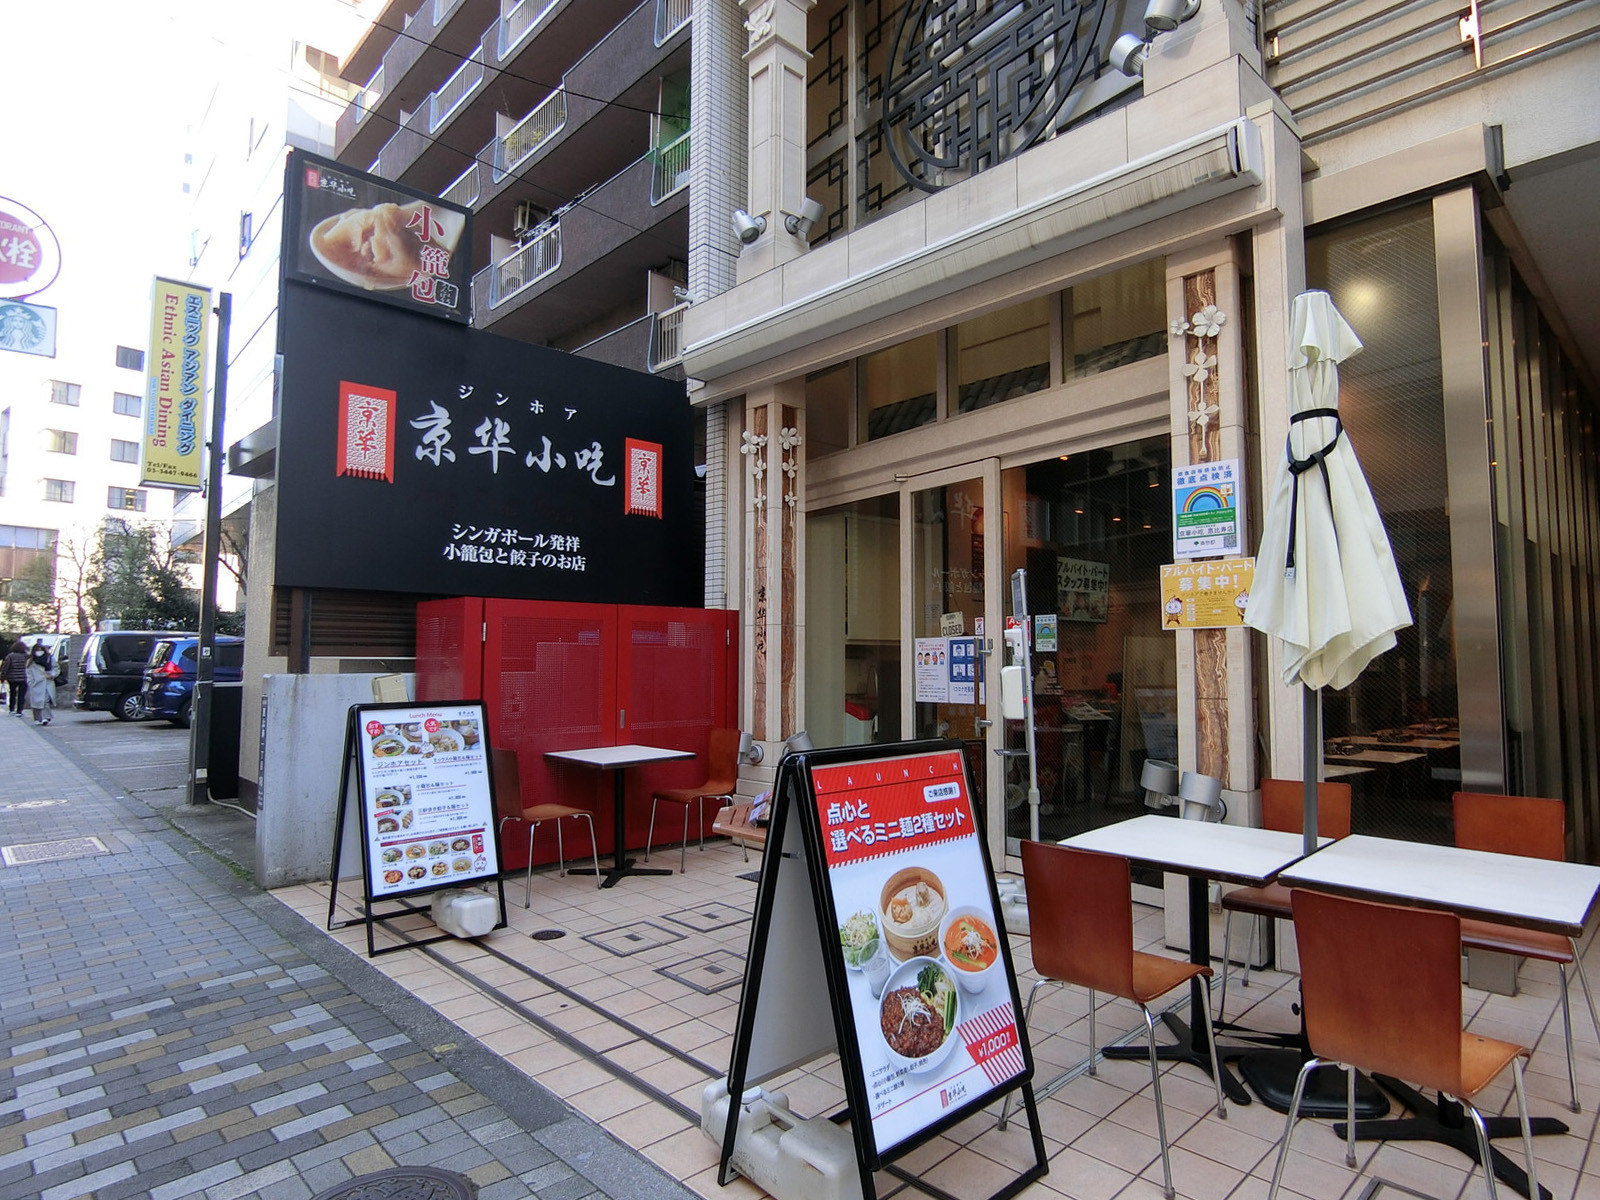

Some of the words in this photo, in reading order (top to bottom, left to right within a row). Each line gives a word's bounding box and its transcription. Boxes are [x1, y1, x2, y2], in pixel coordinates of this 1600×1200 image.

[0, 220, 29, 234] DRANT
[406, 205, 450, 304] 小籠包
[163, 293, 179, 344] Ethnic
[184, 294, 202, 346] エスニック
[160, 348, 175, 392] Asian
[180, 348, 200, 395] アジアン
[458, 384, 578, 421] ジンホア
[153, 397, 172, 447] Dining
[147, 461, 177, 469] Tel/Fax
[452, 523, 580, 552] シンガポール発祥
[443, 543, 586, 571] 小籠包と餃子のお店
[1163, 560, 1252, 577] アルバイト・パート
[942, 624, 962, 636] CLOSED
[827, 799, 870, 826] 点心と
[830, 807, 965, 852] 選べるミニ麺2種セット
